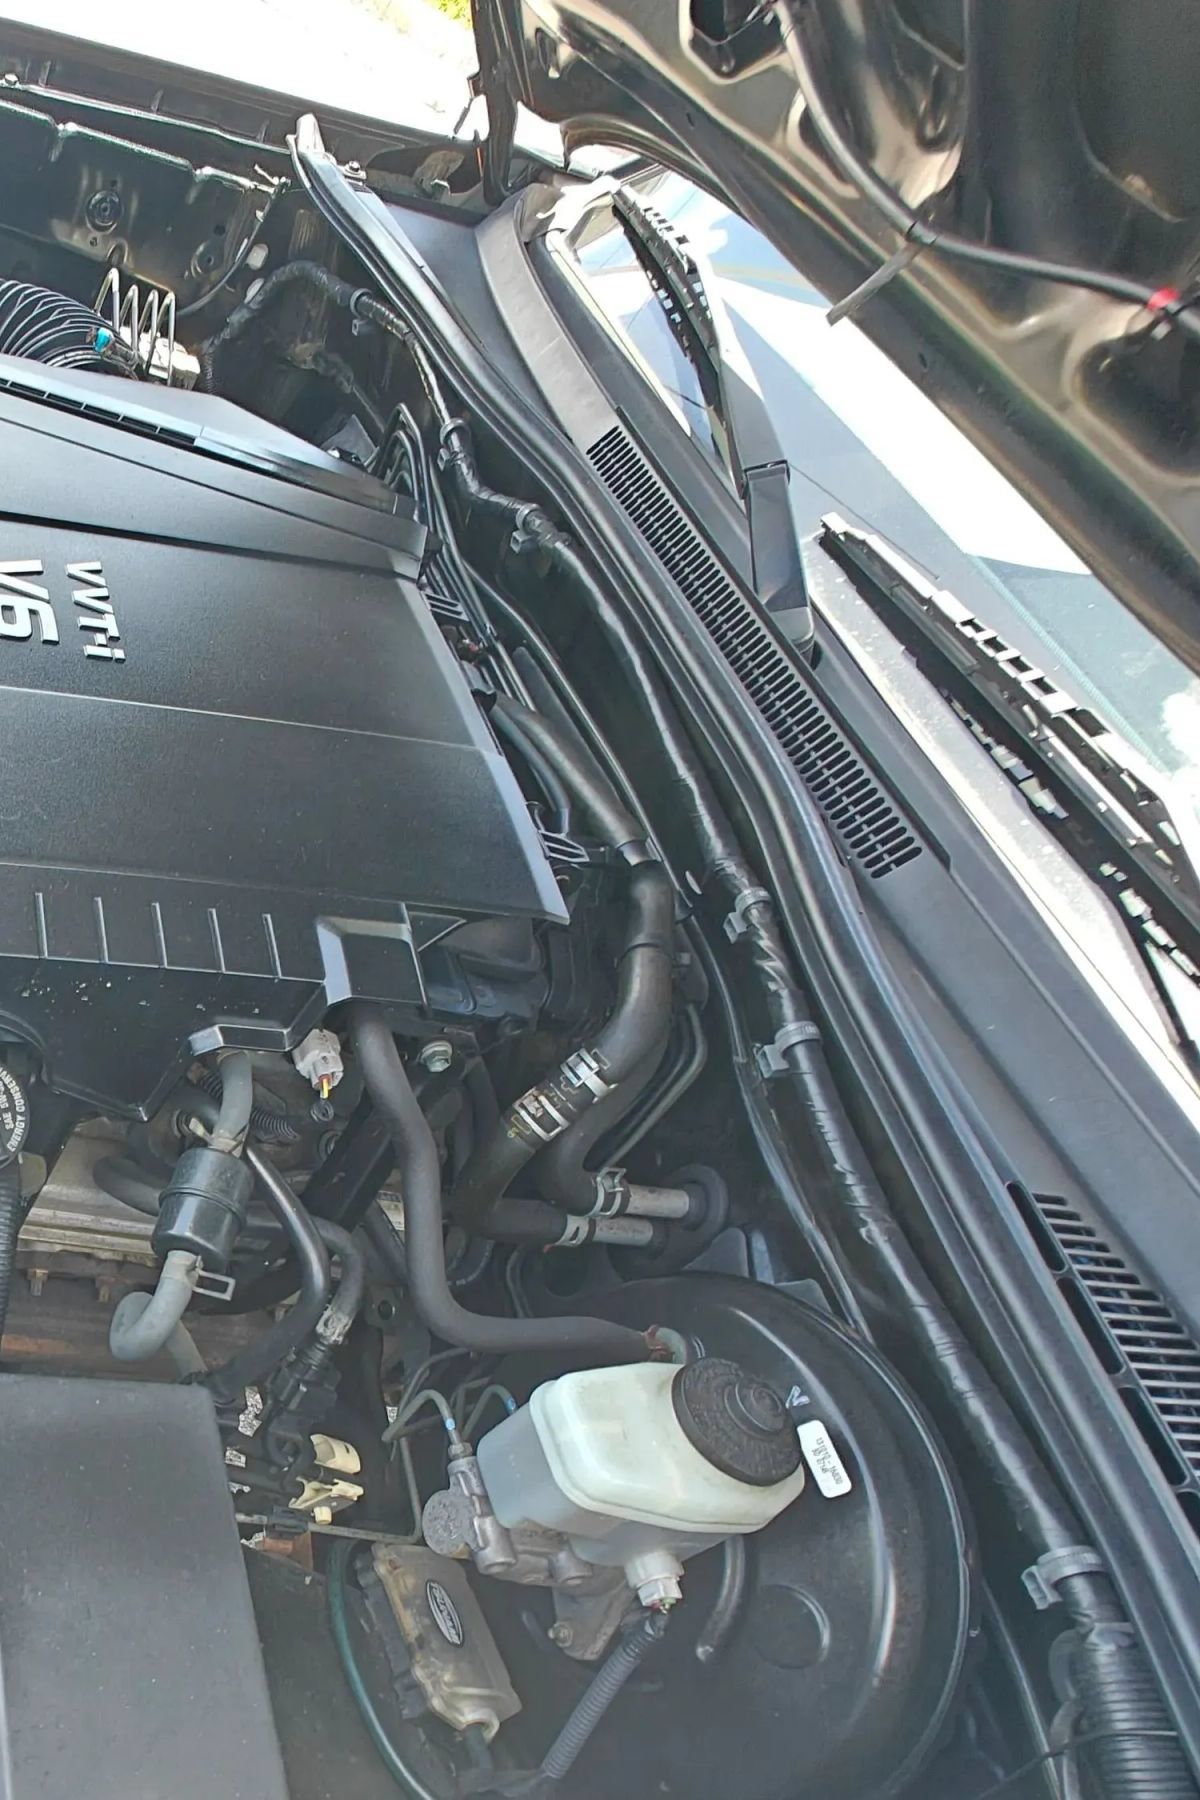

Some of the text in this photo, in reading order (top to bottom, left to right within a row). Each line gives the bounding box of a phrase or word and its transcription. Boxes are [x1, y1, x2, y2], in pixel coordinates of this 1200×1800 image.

[65, 561, 126, 663] VVT-i
[2, 1112, 15, 1130] SAE
[7, 1114, 26, 1152] ENERGY
